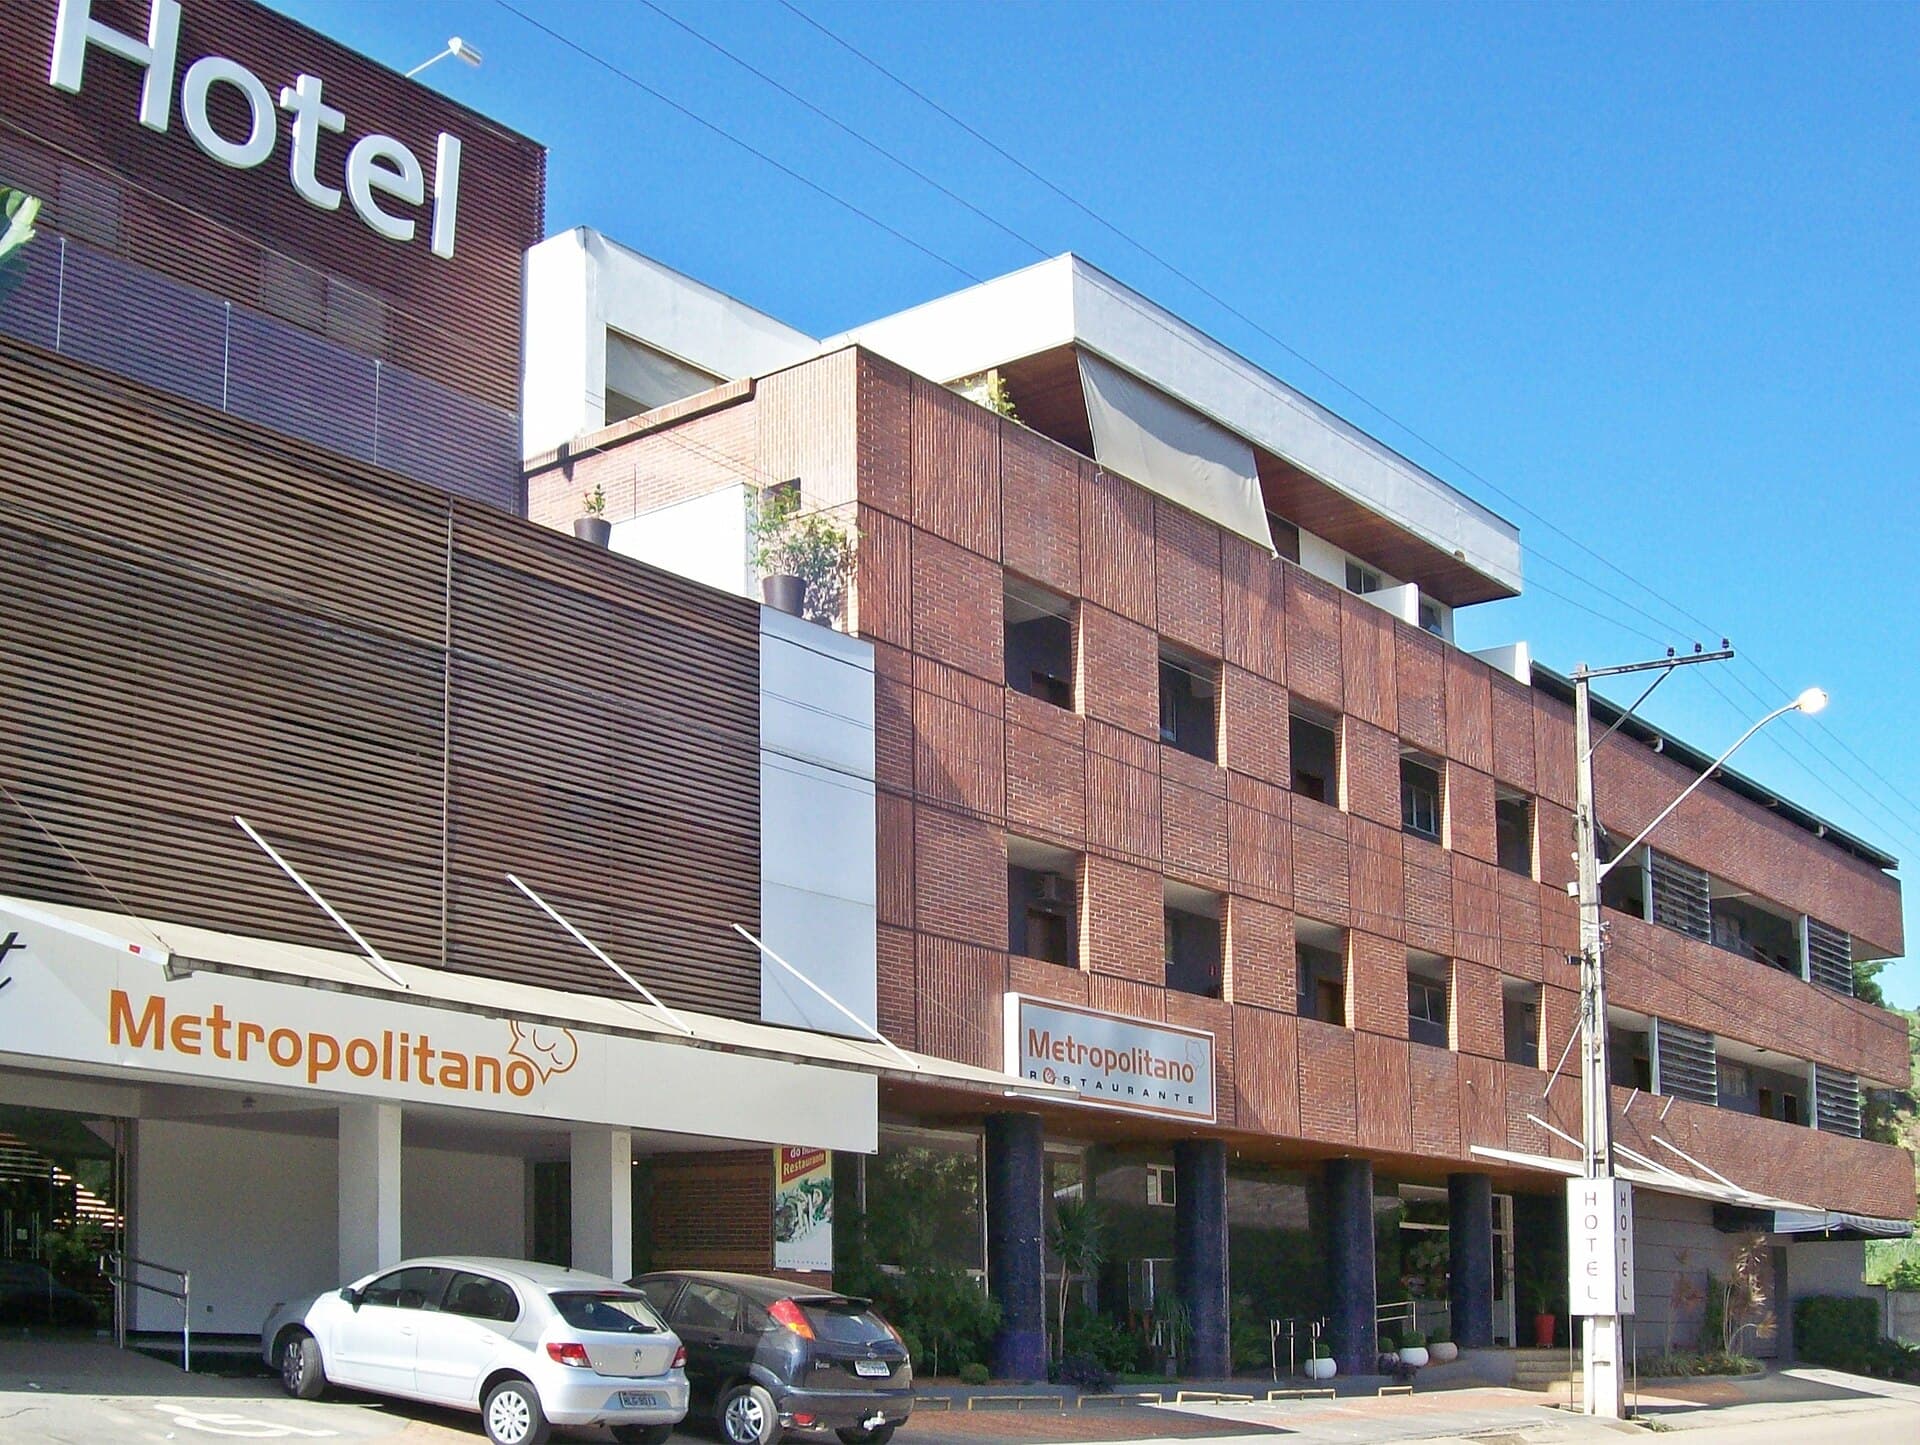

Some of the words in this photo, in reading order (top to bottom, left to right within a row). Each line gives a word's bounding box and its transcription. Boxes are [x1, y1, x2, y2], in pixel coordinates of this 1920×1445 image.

[49, 0, 461, 260] Hotel
[108, 989, 536, 1097] Metropolitano
[1028, 1027, 1195, 1083] Metropolitano
[1584, 1191, 1599, 1300] HOTEL
[1620, 1191, 1628, 1300] HOTEL
